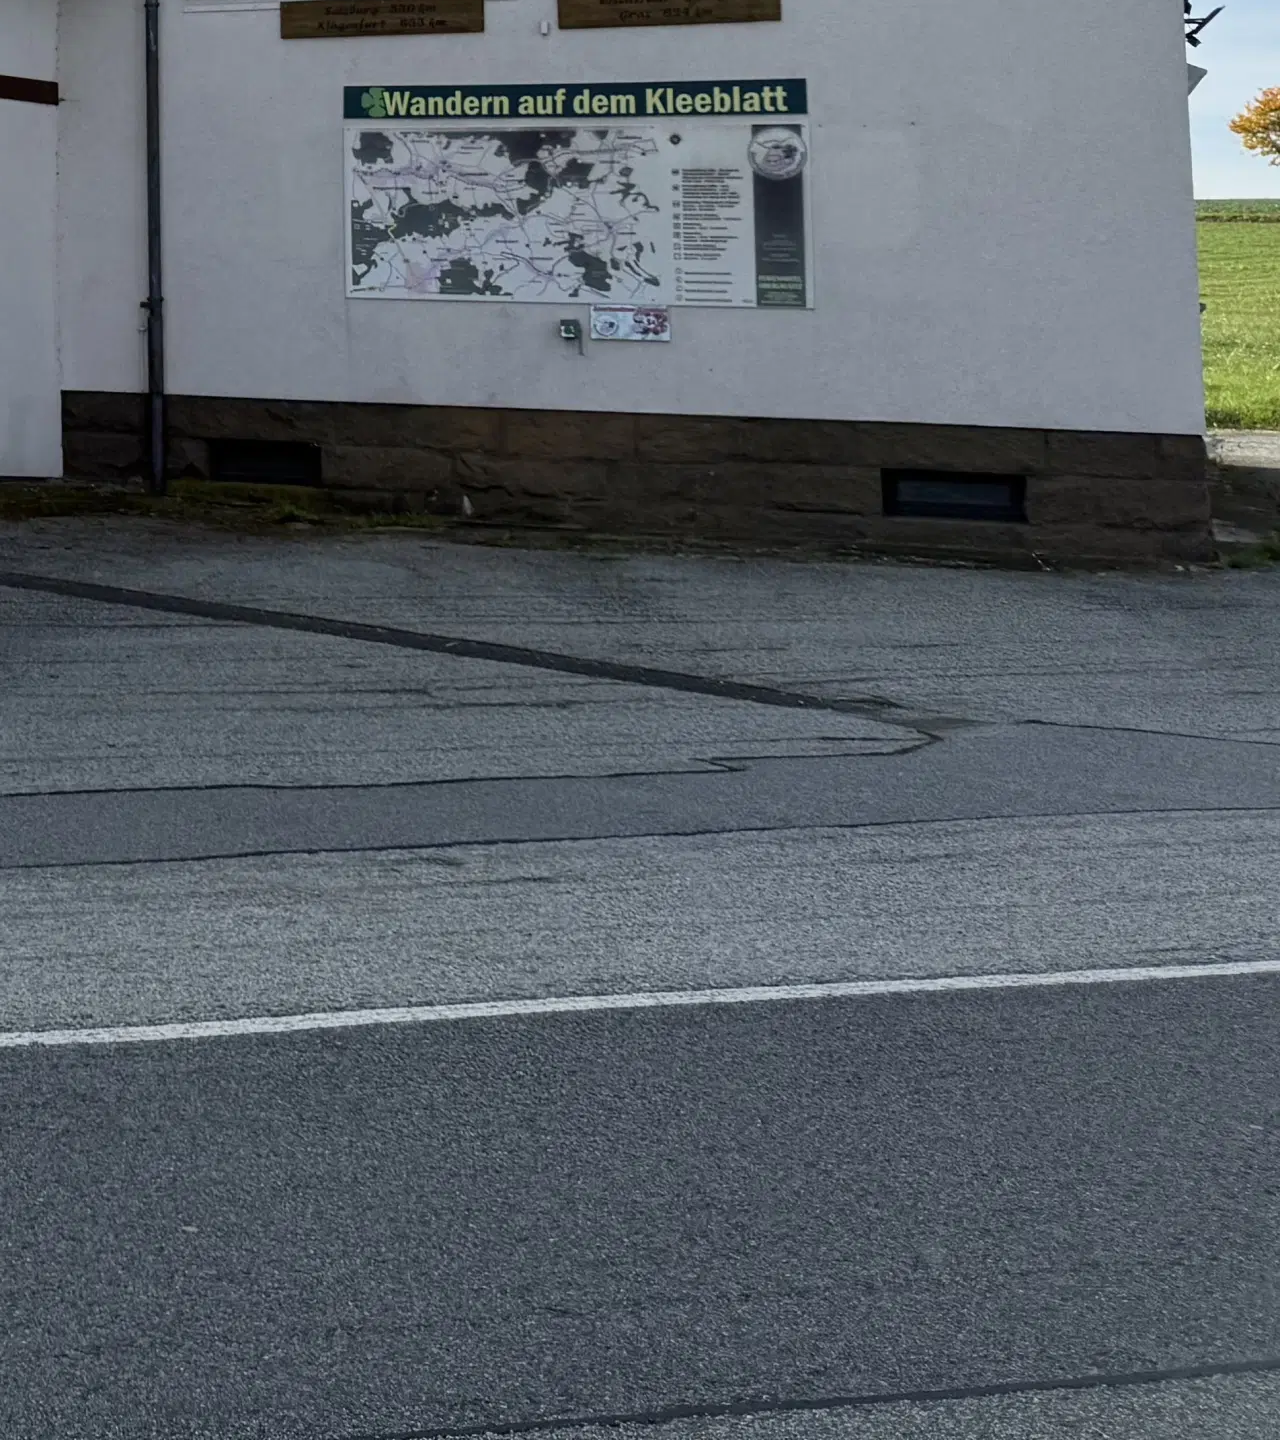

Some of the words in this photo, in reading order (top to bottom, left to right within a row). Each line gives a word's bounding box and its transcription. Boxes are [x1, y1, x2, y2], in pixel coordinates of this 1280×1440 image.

[383, 90, 509, 116] Wandern
[519, 88, 566, 114] auf
[574, 88, 635, 114] dem
[646, 85, 788, 113] Kleeblatt
